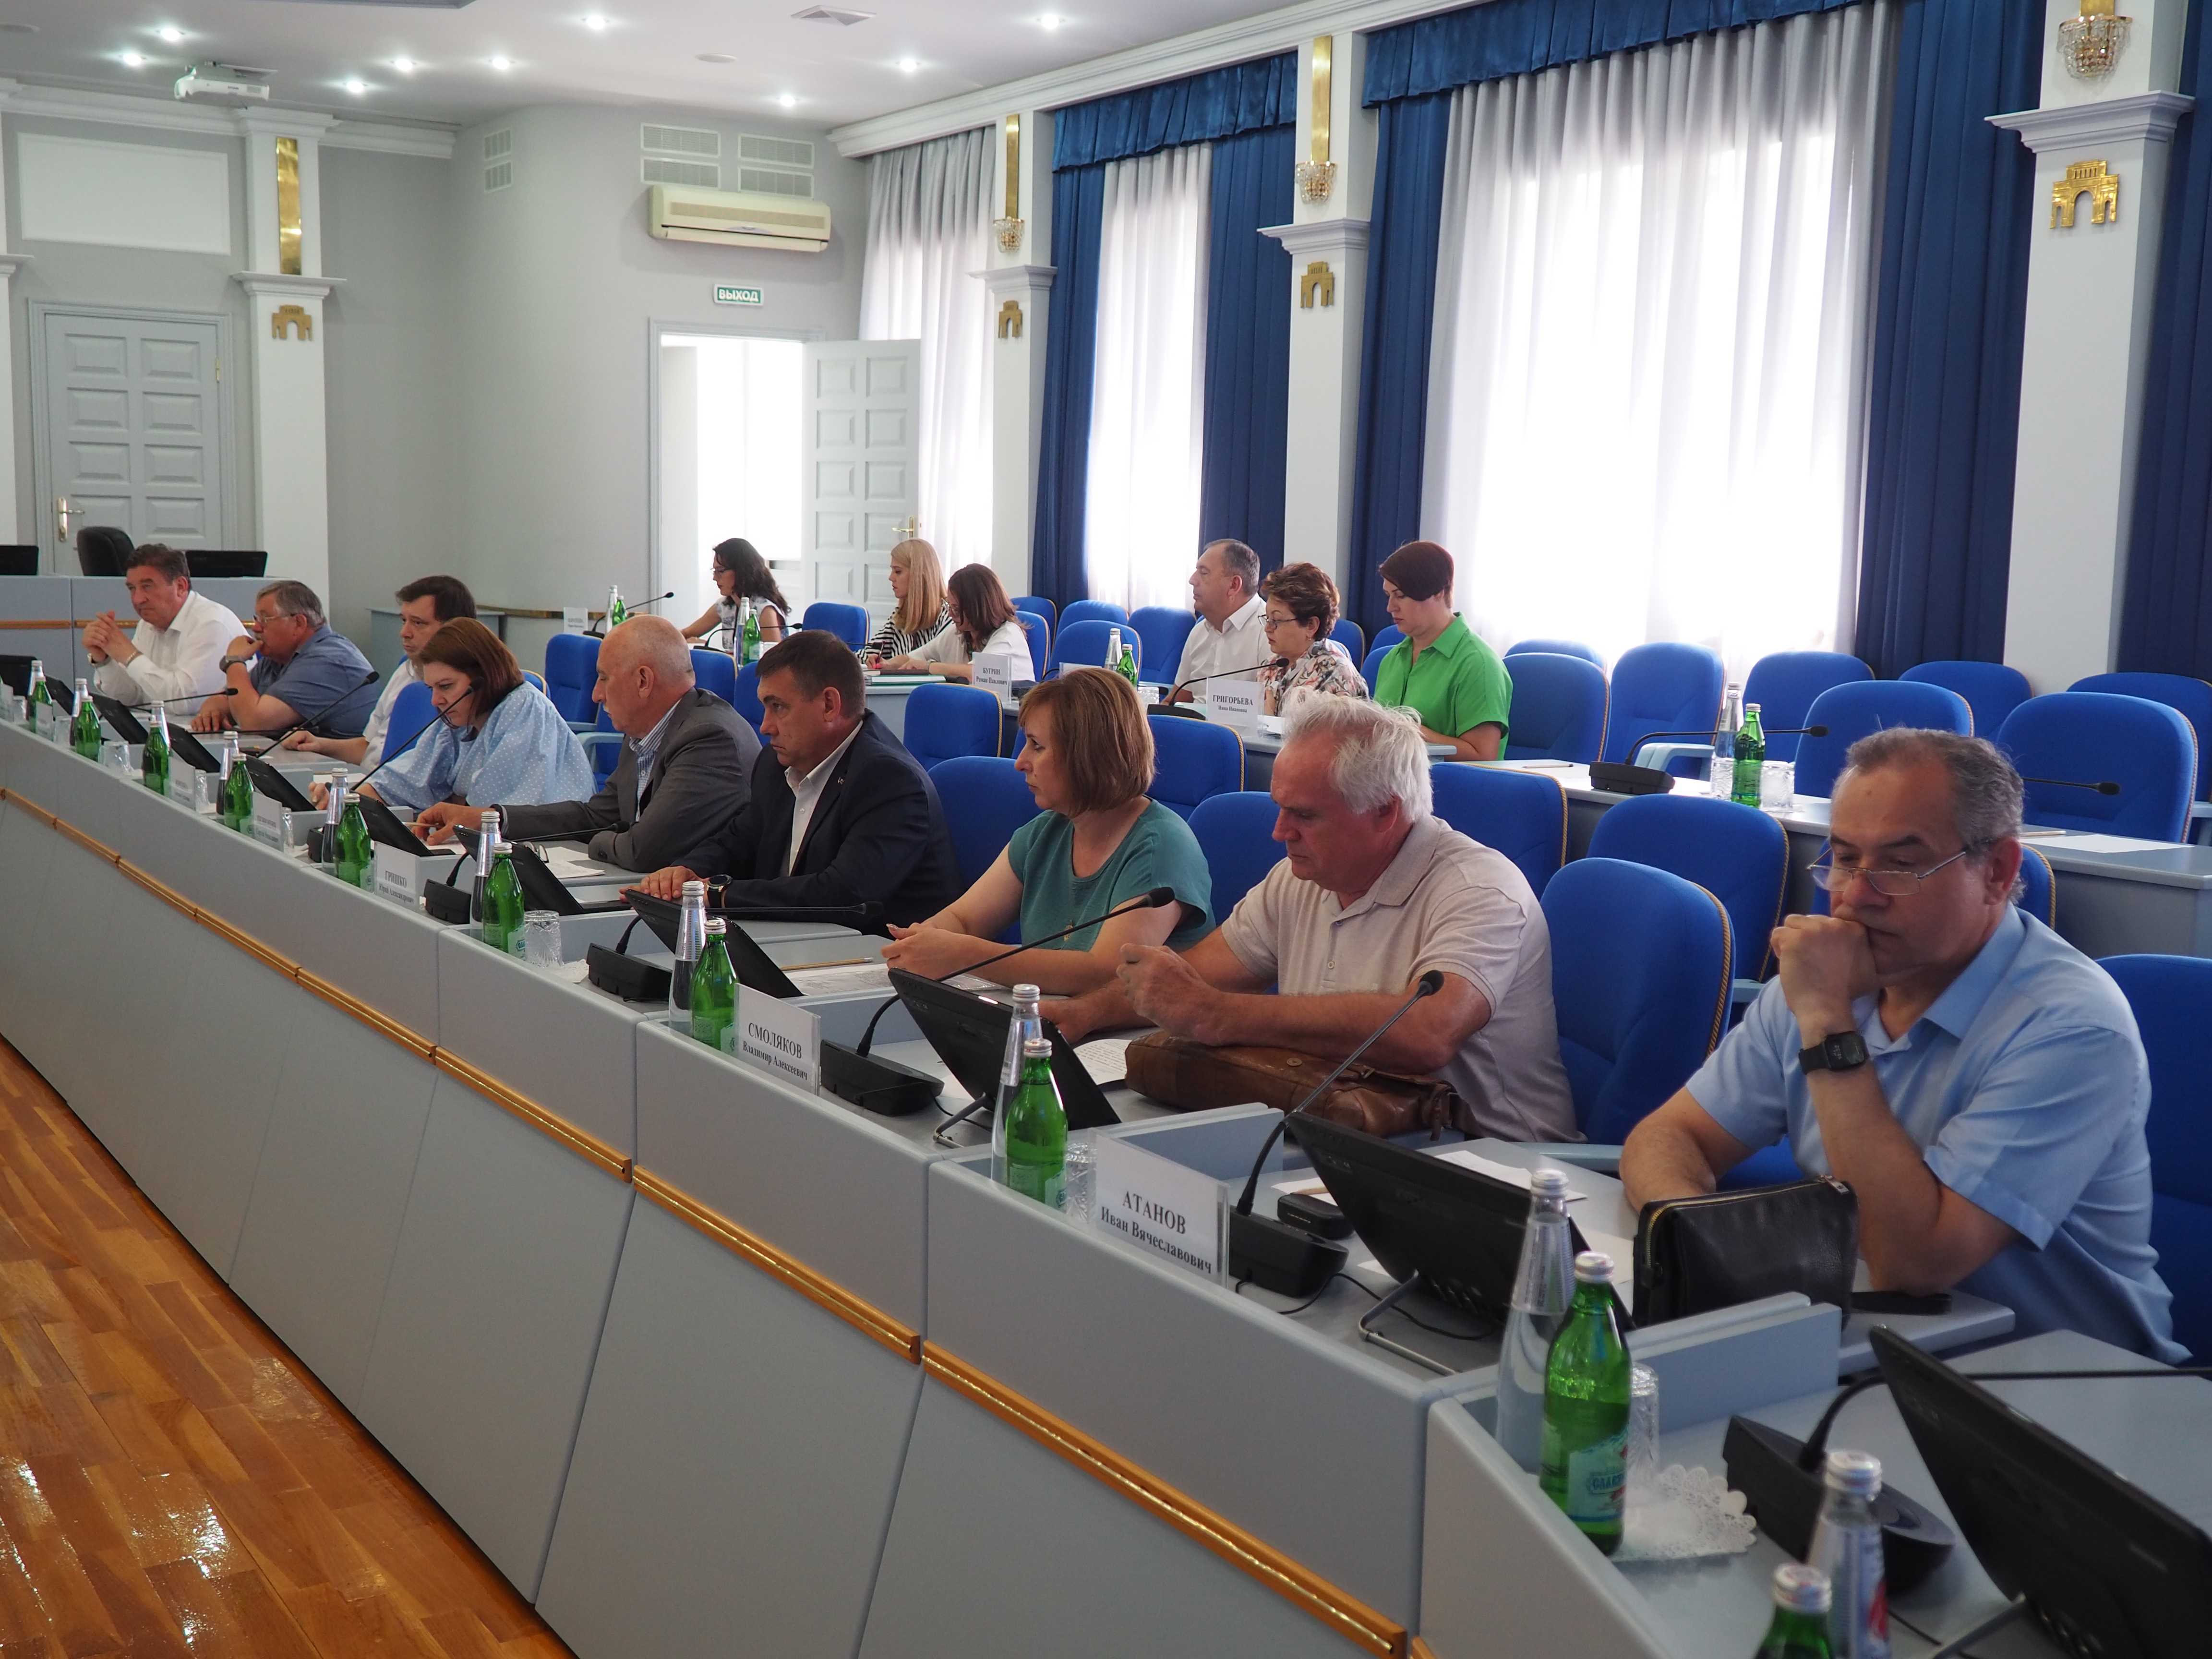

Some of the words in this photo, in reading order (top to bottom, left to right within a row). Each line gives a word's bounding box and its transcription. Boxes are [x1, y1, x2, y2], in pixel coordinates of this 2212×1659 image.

[719, 289, 759, 302] ВЫХОД
[983, 667, 1000, 675] БУГРИН
[1213, 695, 1253, 706] ГРИГОРЬЕВА
[385, 870, 407, 888] ГРИШКО
[748, 1022, 802, 1059] СМОЛЯКОВ
[743, 1041, 772, 1065] Владимир
[773, 1056, 807, 1080] Алексеевич
[1122, 1190, 1186, 1234] АТАНОВ
[1101, 1206, 1128, 1232] Иван
[1132, 1221, 1212, 1274] Вячеславович
